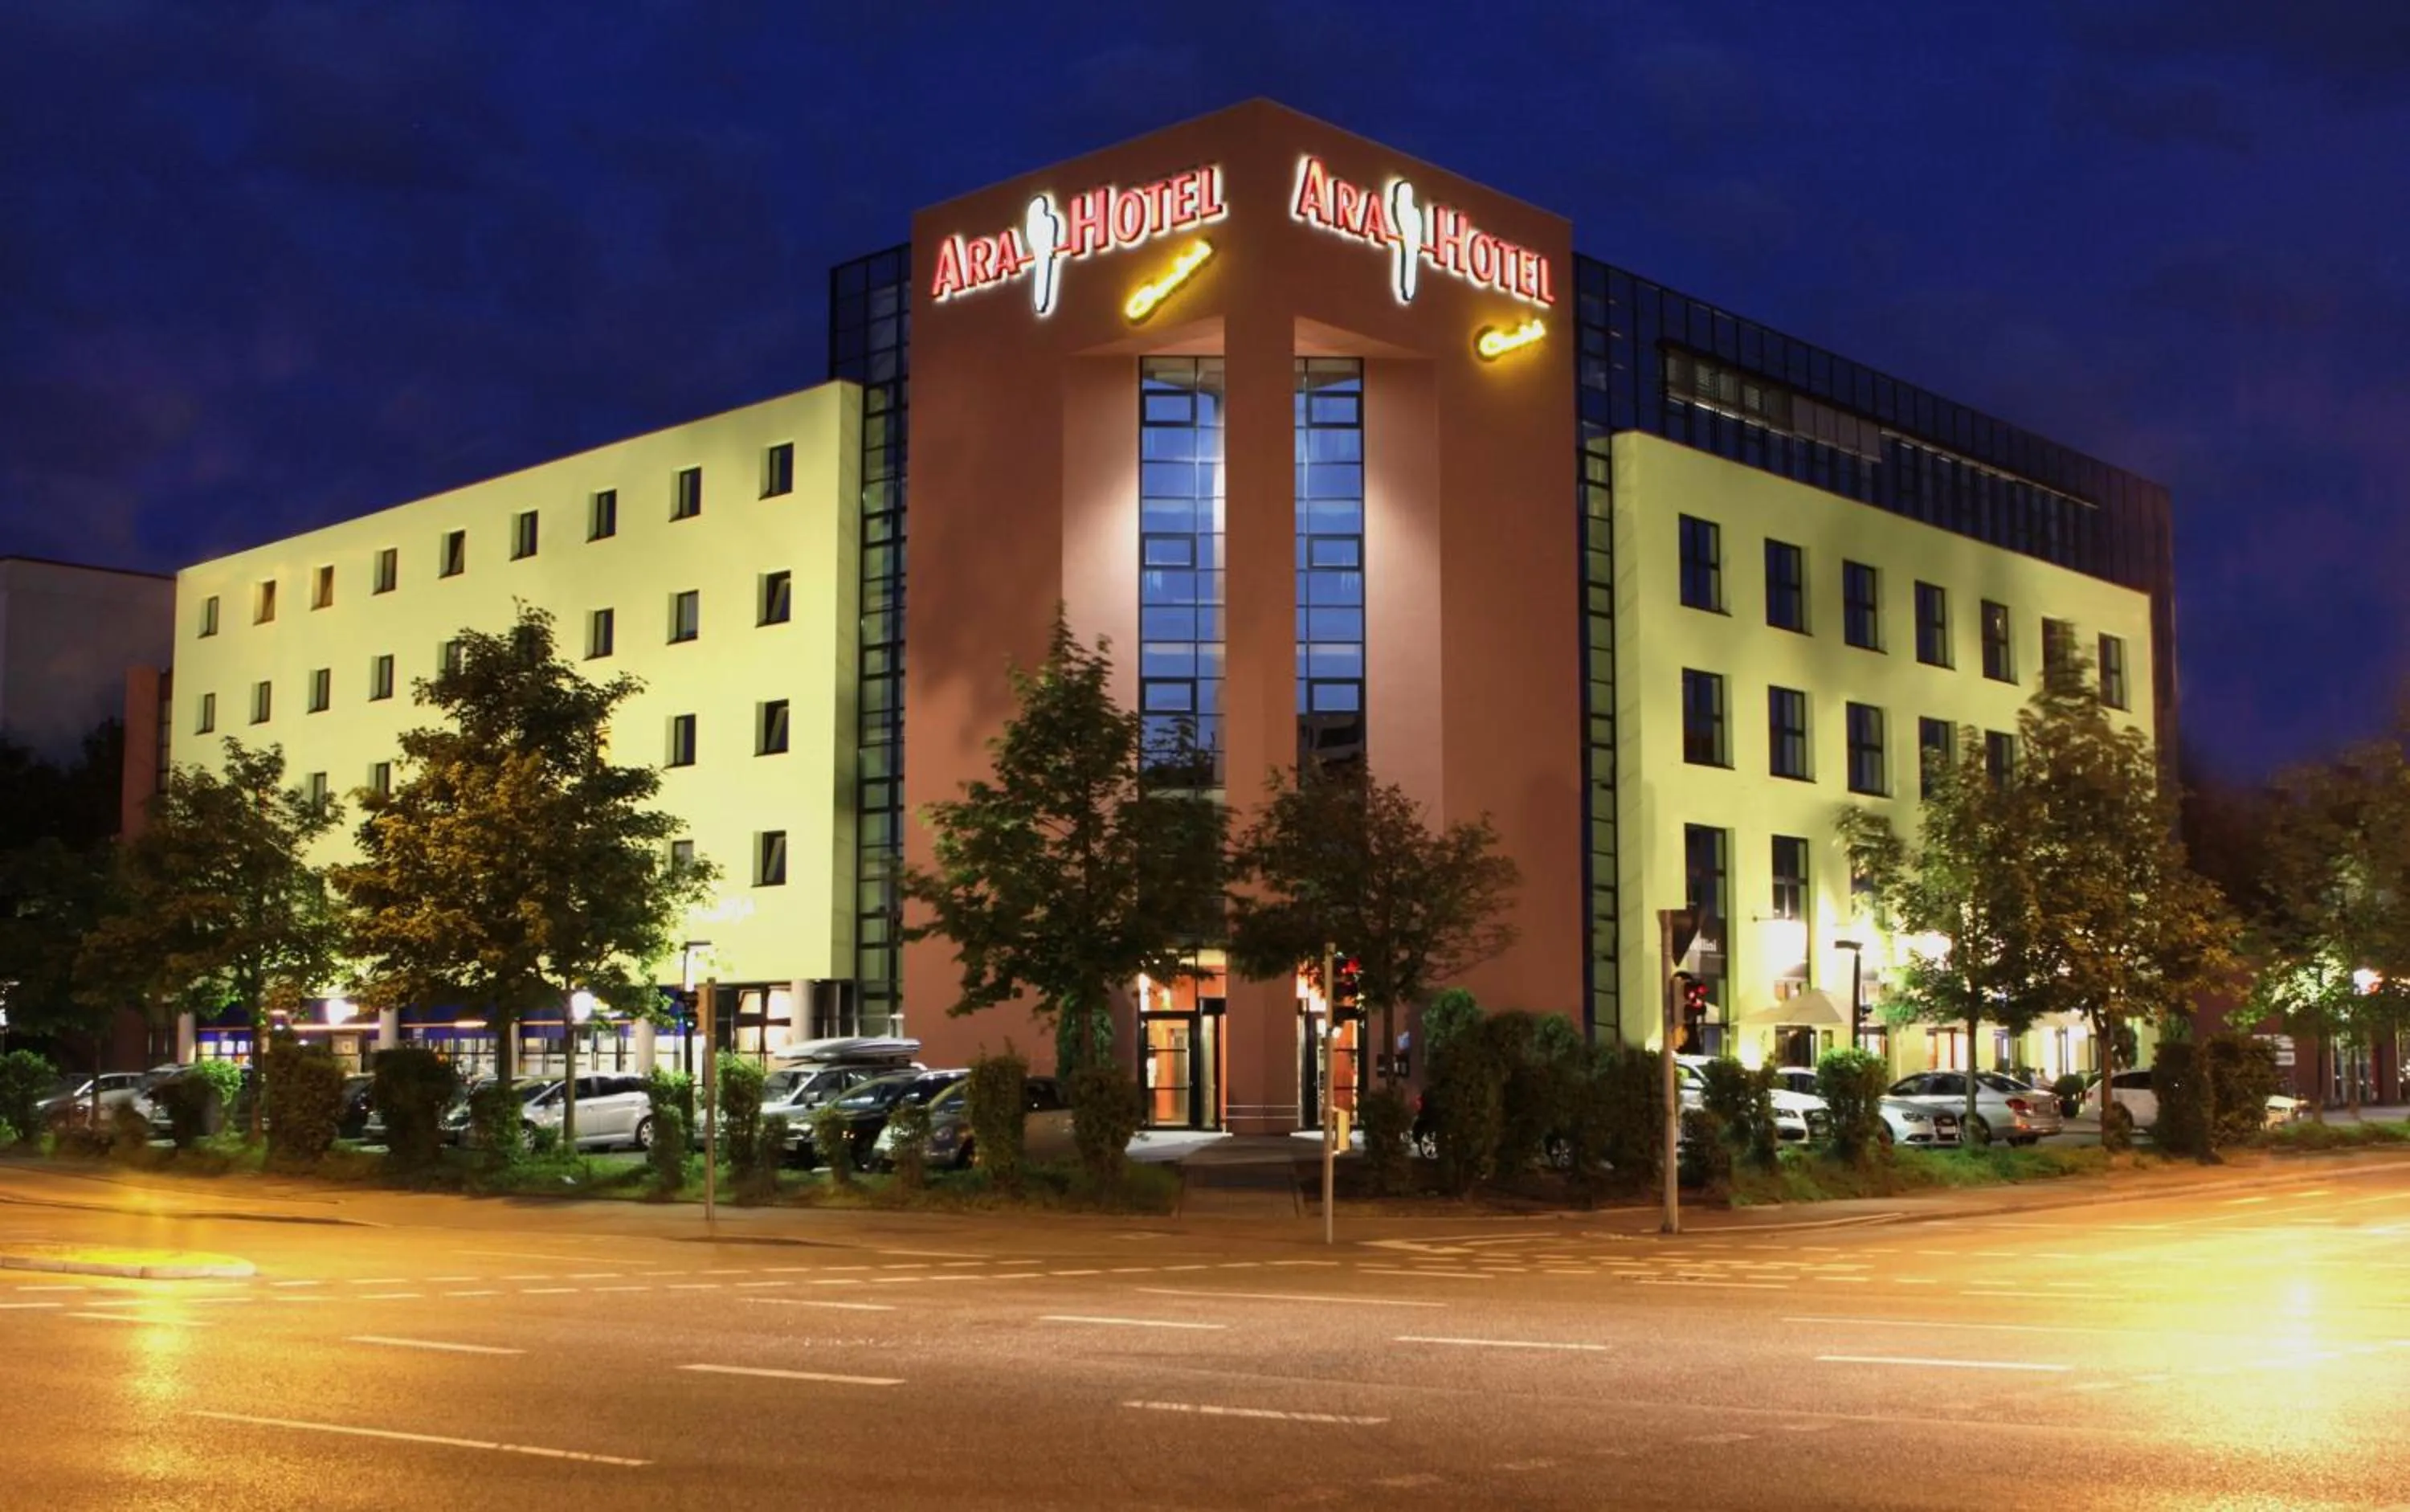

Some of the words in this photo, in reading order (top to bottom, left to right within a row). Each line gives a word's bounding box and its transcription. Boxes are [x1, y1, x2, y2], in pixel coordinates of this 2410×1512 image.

[931, 232, 1024, 302] ARA
[1066, 166, 1227, 259] HOTEL
[1291, 154, 1395, 249] ARA
[1424, 202, 1556, 310] HOTEL
